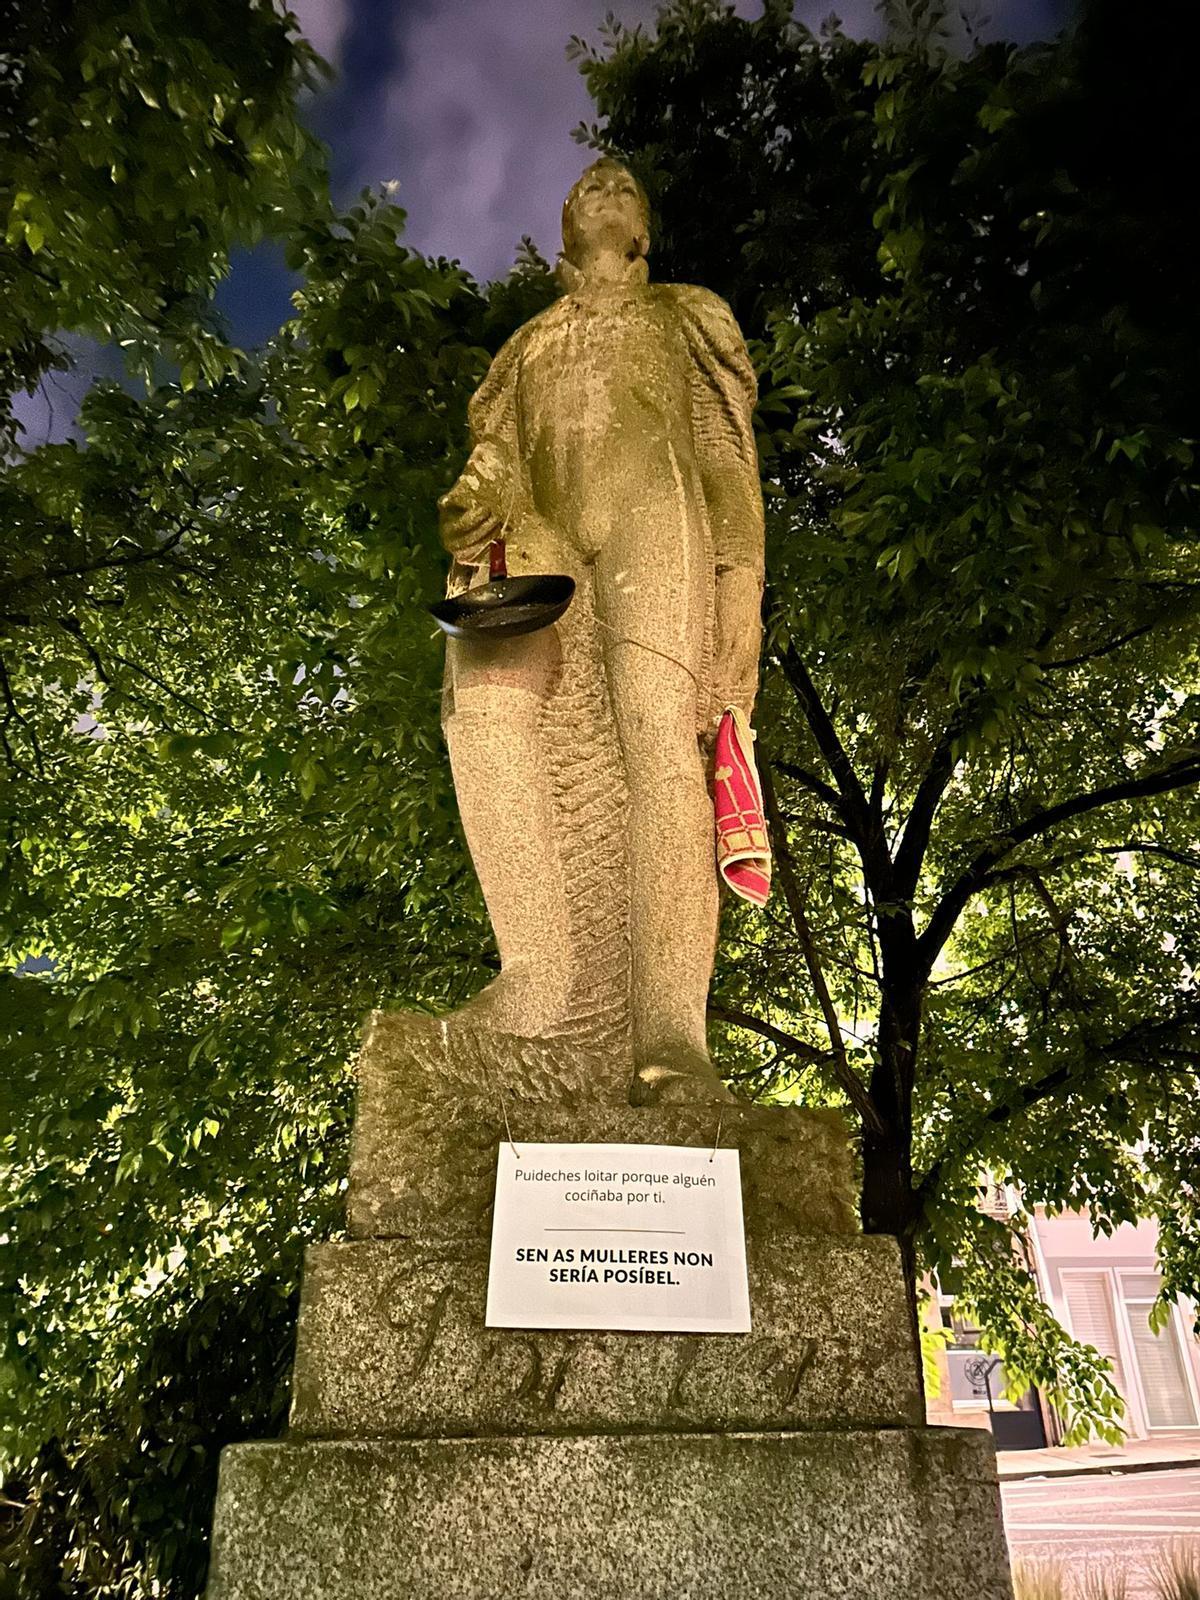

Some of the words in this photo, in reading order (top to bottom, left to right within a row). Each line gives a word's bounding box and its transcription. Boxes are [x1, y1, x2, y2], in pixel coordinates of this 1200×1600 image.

[516, 1170, 580, 1181] Puideches
[585, 1170, 617, 1181] loitar
[622, 1173, 668, 1185] porque
[673, 1173, 715, 1188] alguén
[565, 1189, 623, 1202] cociñaba
[627, 1191, 650, 1206] por
[653, 1191, 666, 1204] ti.
[516, 1248, 548, 1262] SEN
[553, 1249, 574, 1262] AS
[581, 1249, 668, 1264] MULLERES
[674, 1252, 712, 1266] NON
[550, 1265, 599, 1283] SERÍA
[604, 1267, 680, 1285] POSÍBEL.
